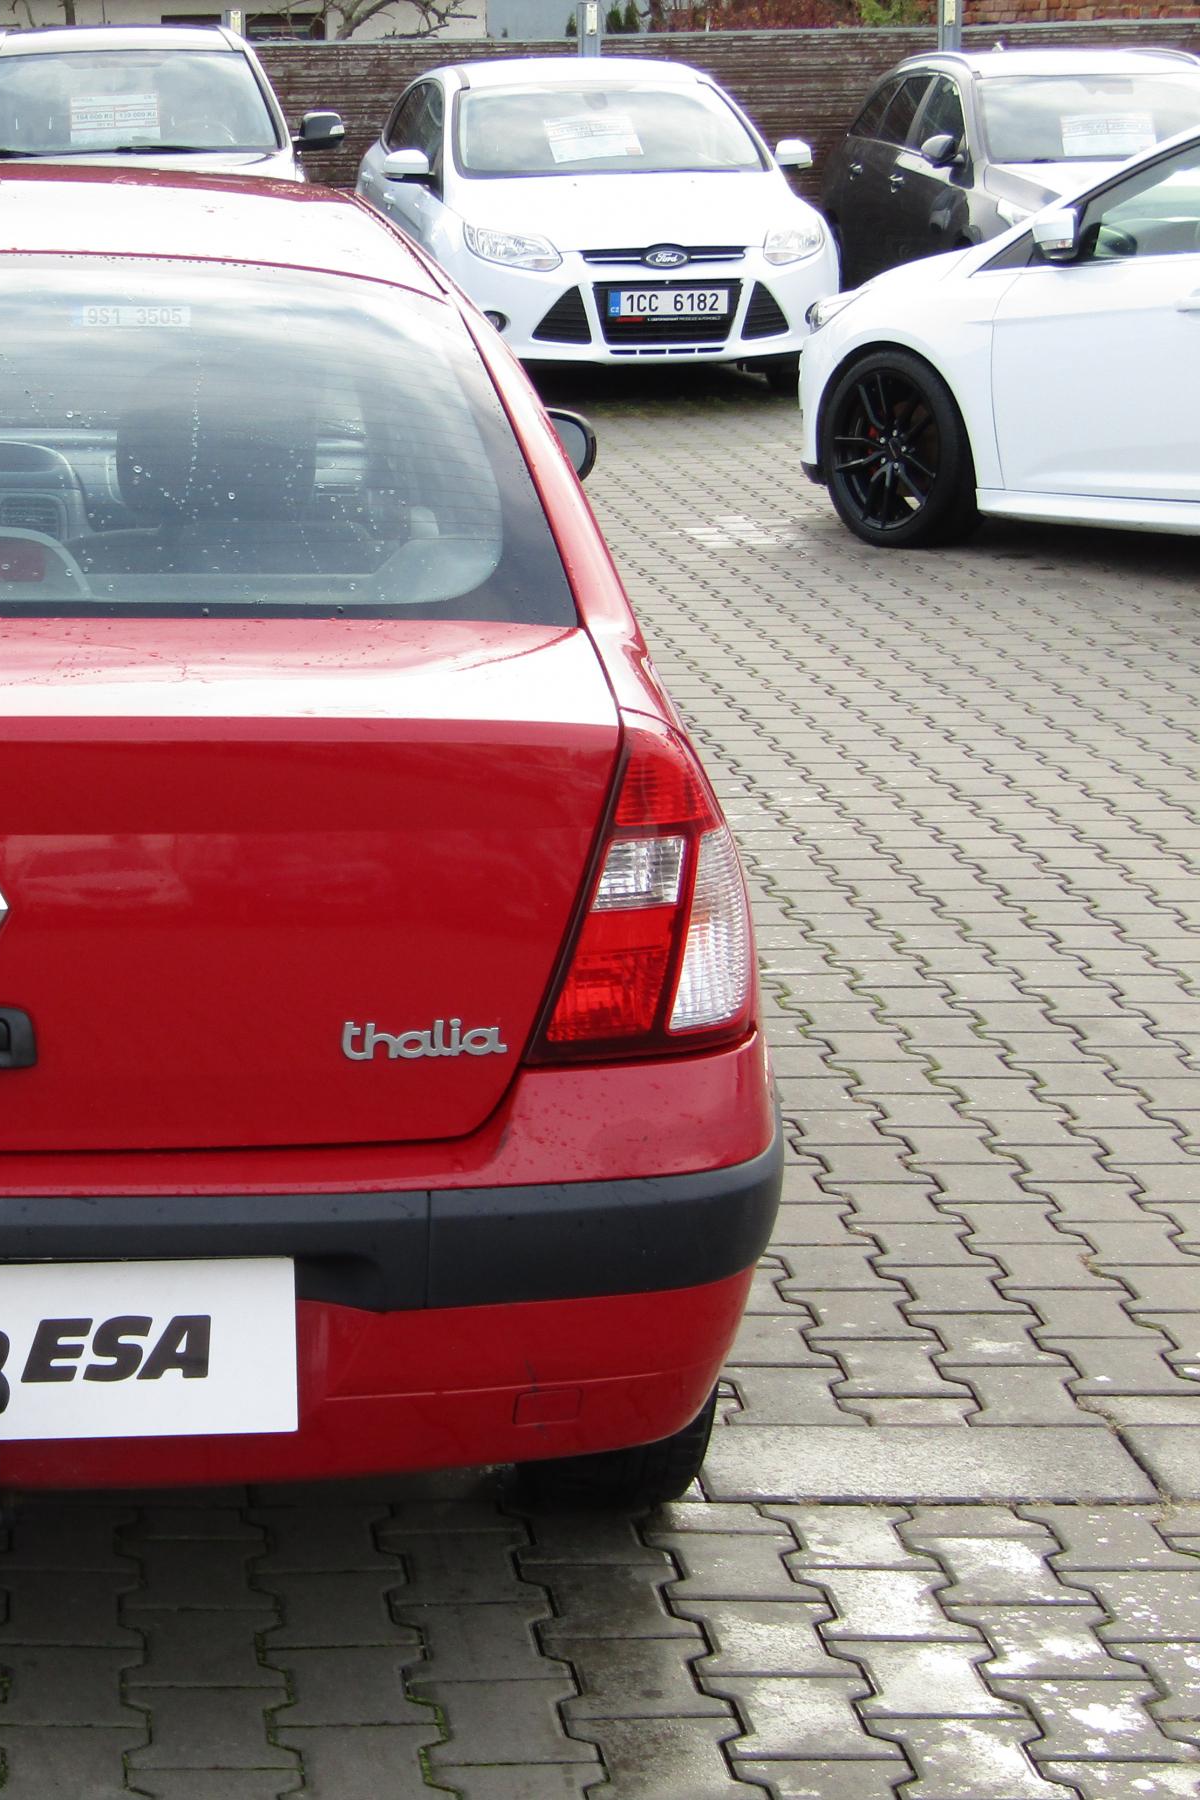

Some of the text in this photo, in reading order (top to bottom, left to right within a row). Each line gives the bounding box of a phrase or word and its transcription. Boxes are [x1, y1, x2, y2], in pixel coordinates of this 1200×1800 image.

[655, 252, 679, 263] Ford
[626, 293, 719, 313] 1CC 6182
[87, 308, 182, 325] 9S1 3505
[342, 1018, 508, 1060] thalia
[20, 1314, 212, 1383] ESA
